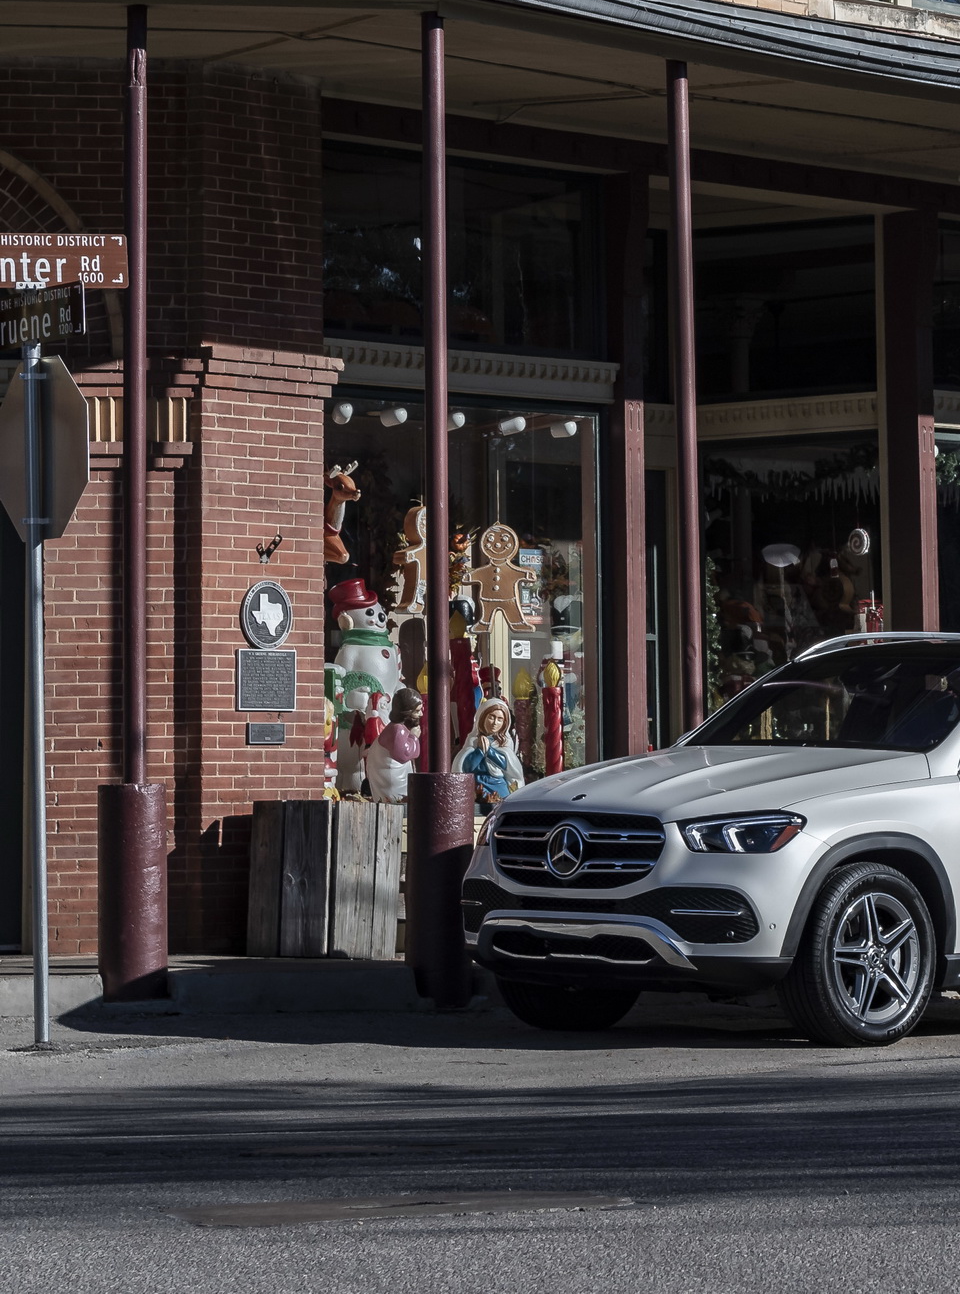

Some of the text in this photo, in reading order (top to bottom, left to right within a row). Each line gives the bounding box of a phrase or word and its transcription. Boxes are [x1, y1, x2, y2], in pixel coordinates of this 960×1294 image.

[1, 234, 106, 247] HISTORIC DISTRICT
[81, 255, 101, 272] Rd
[77, 272, 104, 283] 1600
[44, 286, 71, 302] DISTRICT
[59, 304, 72, 323] Rd
[58, 322, 74, 335] 1200
